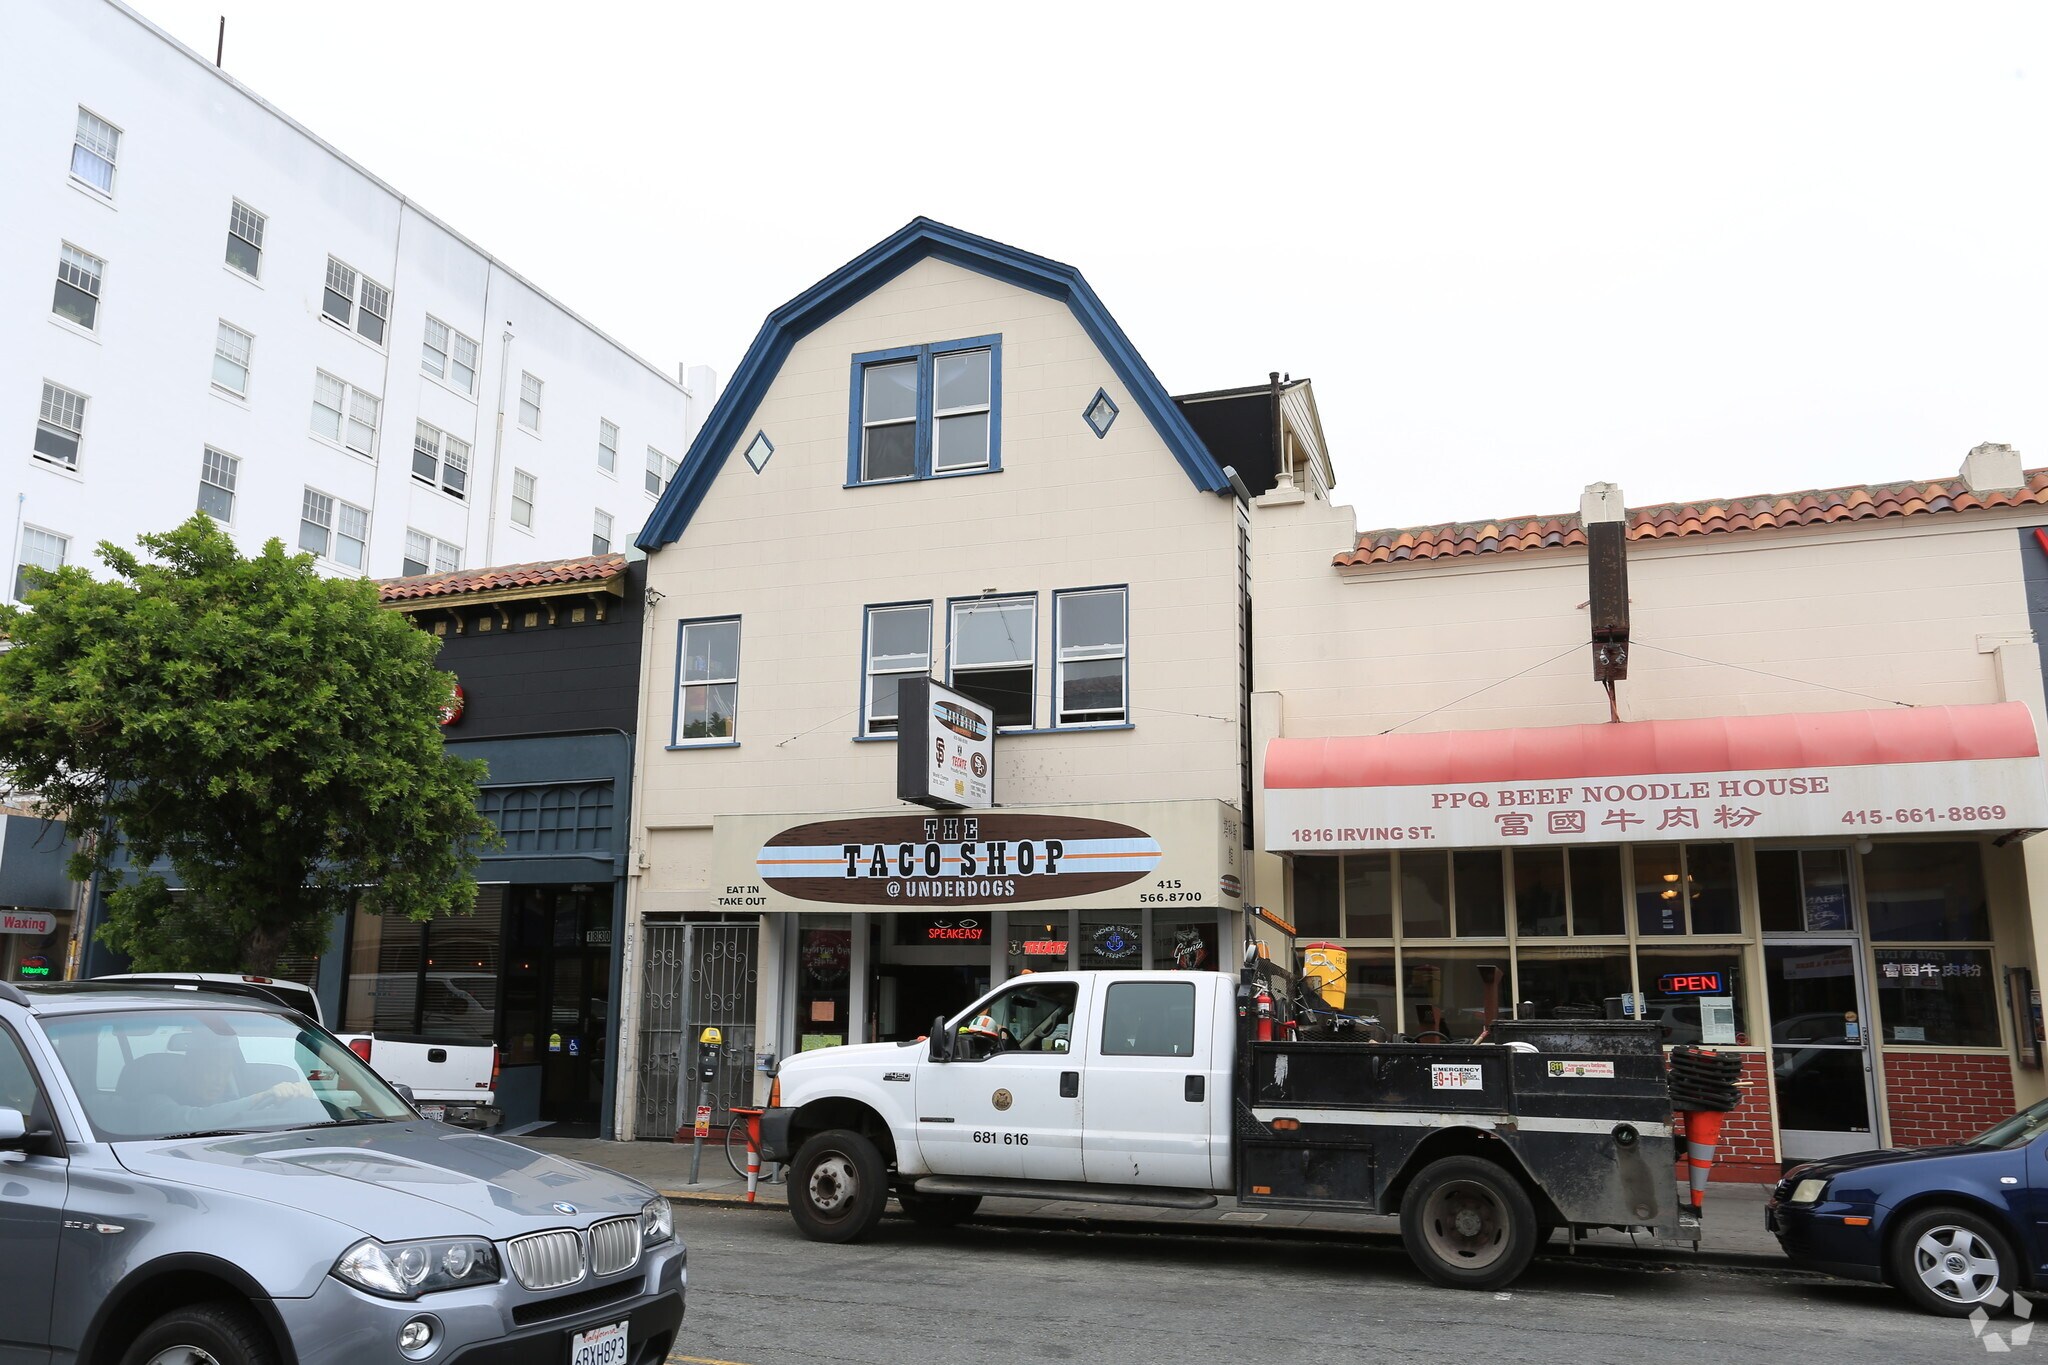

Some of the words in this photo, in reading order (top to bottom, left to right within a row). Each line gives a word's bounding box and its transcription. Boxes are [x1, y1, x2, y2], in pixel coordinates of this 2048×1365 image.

[1431, 790, 1489, 809] PPQ
[1497, 787, 1573, 807] BEEF
[1582, 780, 1710, 803] NOODLE
[1718, 776, 1829, 798] HOUSE
[1494, 803, 1762, 837] 富國牛肉粉
[1841, 804, 2007, 826] 415-661-8869
[924, 818, 978, 841] THE
[1291, 828, 1333, 842] 1816
[1337, 826, 1404, 842] IRVING
[1407, 826, 1436, 840] ST.
[841, 842, 943, 879] TACO
[959, 839, 1064, 877] SHOP
[726, 885, 745, 894] EAT
[747, 885, 760, 894] IN
[906, 879, 1015, 897] UNDERDOGS
[1157, 879, 1182, 889] 415
[718, 897, 743, 906] TAKE
[745, 897, 767, 906] OUT
[1140, 891, 1202, 903] 566.8700
[4, 916, 47, 932] Waxing
[586, 930, 611, 943] 1830
[928, 928, 983, 940] SPEAKEASY
[1093, 925, 1116, 941] ANCHOR
[1116, 925, 1138, 940] STEAM
[1022, 940, 1069, 956] TECATE
[21, 966, 49, 976] Waxing
[1883, 962, 1982, 978] 富國牛肉粉
[1438, 1071, 1462, 1087] 9-1-1
[973, 1131, 996, 1144] 681
[1004, 1133, 1029, 1146] 616
[575, 1337, 625, 1365] 6BXH893
